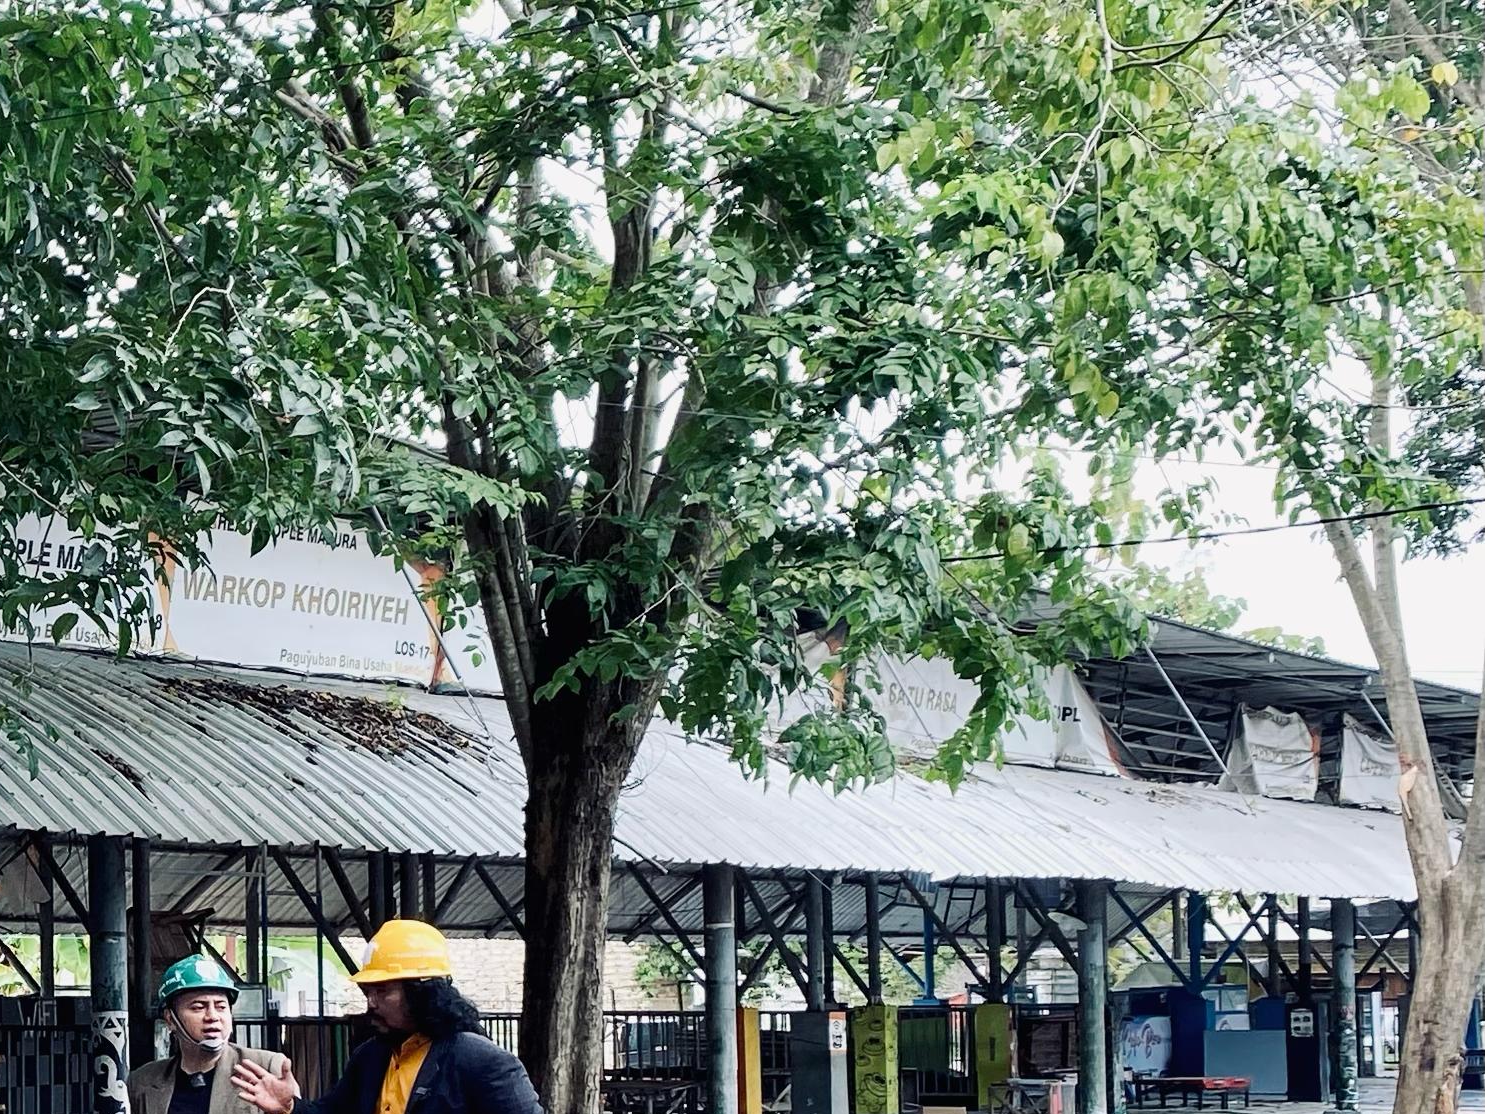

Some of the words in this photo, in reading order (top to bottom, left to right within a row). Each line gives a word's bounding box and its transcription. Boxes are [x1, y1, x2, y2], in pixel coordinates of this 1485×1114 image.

[307, 526, 358, 550] MAURA
[183, 569, 286, 609] WARKOP
[291, 583, 410, 625] KHOIRIYEH
[280, 648, 337, 668] Paguyuban
[339, 654, 361, 668] Bina
[888, 682, 924, 709] SATU
[928, 688, 957, 714] RASA
